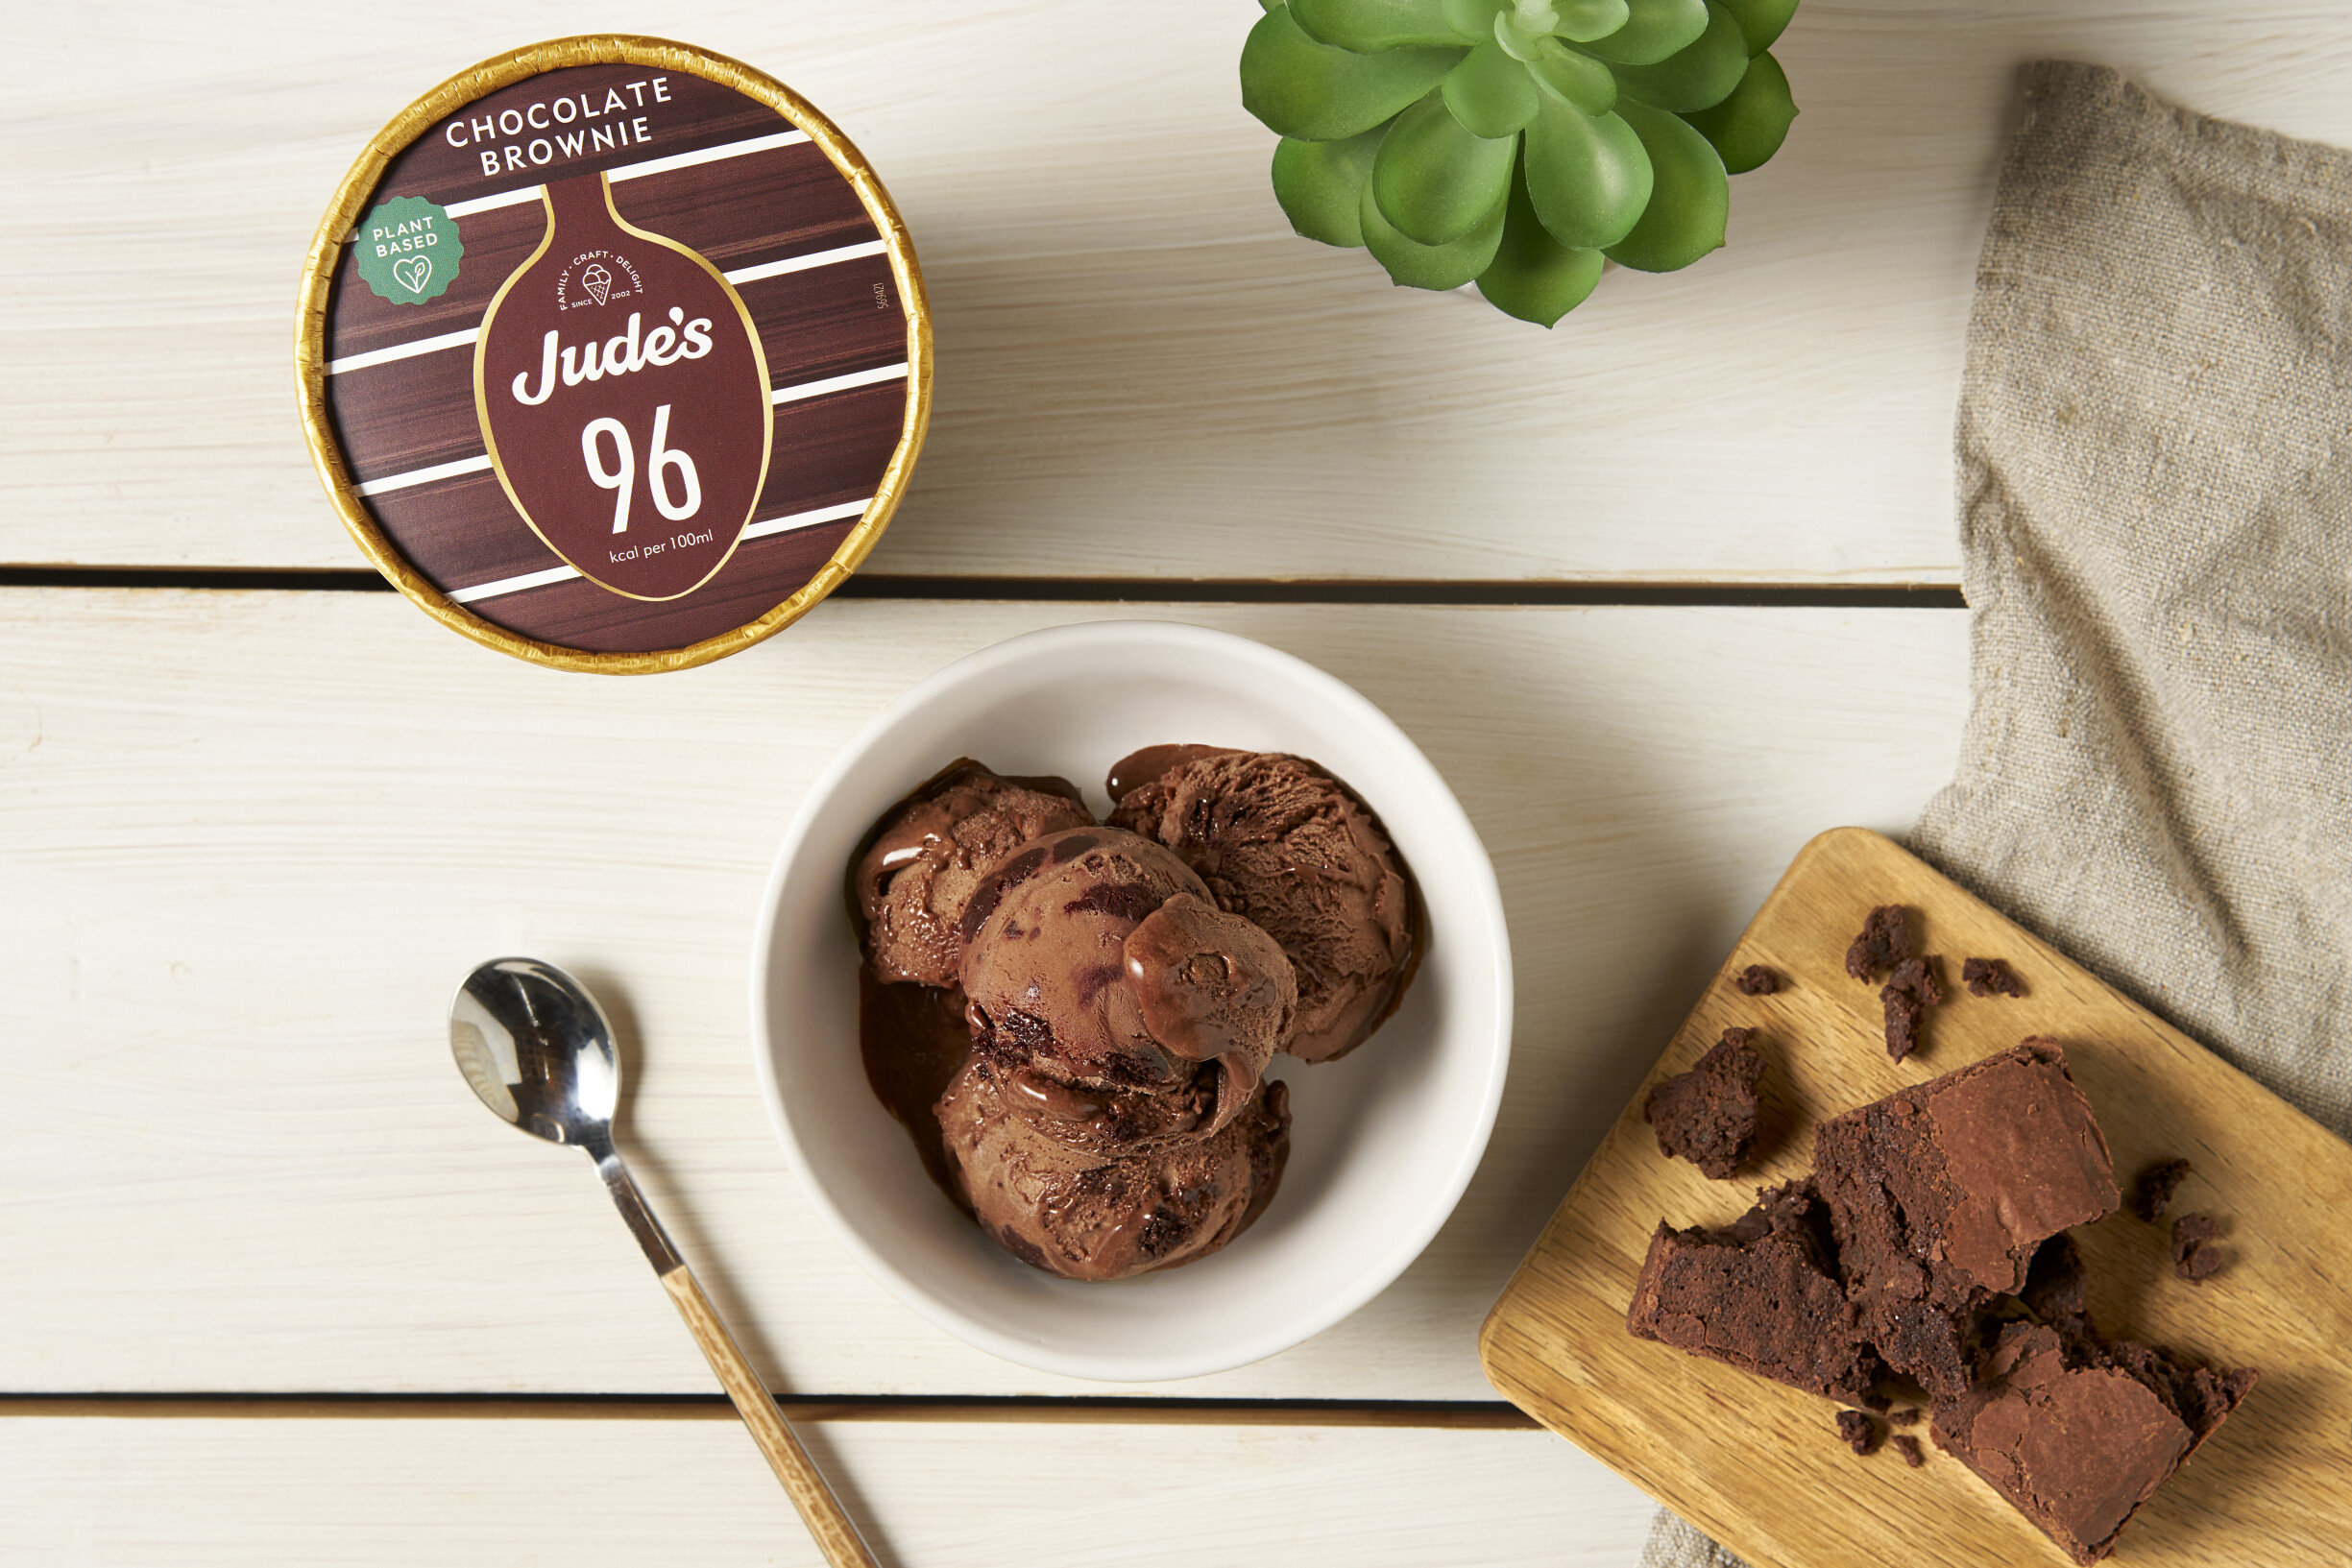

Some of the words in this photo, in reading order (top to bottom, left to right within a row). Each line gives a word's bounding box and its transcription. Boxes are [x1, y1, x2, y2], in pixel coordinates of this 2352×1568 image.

[446, 77, 671, 147] CHOCOLATE
[480, 116, 652, 177] BROWNIE
[373, 216, 432, 241] PLANT
[376, 233, 438, 257] BASED
[557, 270, 570, 311] FAMILY
[573, 251, 608, 265] CRAFT
[616, 255, 643, 294] DELIGHT
[570, 299, 593, 308] SINCE
[611, 290, 630, 300] 2002
[512, 306, 713, 405] Jude's
[581, 403, 702, 534] 96
[609, 545, 639, 563] kcal
[643, 543, 666, 559] per
[670, 528, 713, 549] 100ml
